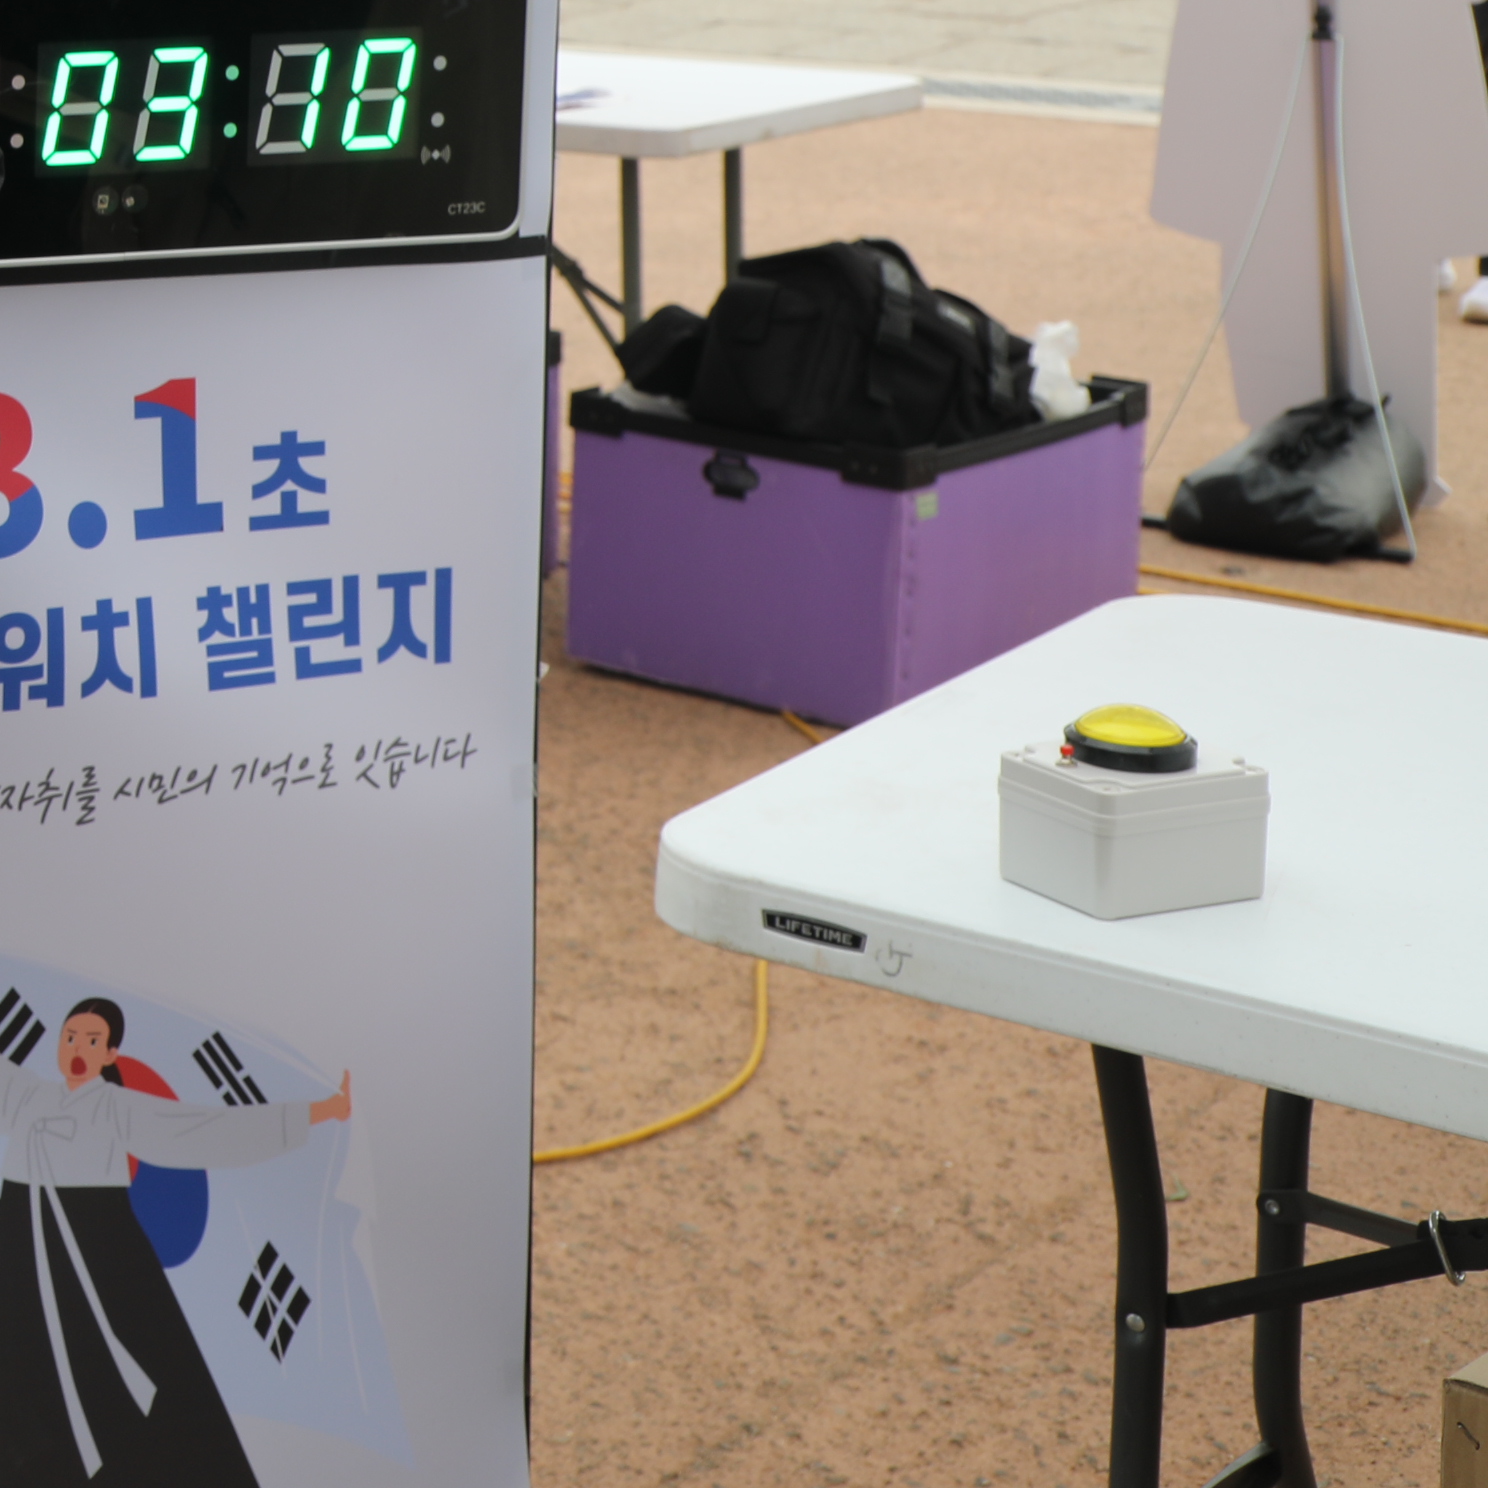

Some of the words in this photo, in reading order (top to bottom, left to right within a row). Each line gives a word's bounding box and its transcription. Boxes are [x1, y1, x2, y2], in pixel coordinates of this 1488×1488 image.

[448, 201, 486, 215] CT23C
[196, 567, 453, 692] 챌린지
[113, 763, 218, 804] 시민의
[232, 742, 340, 790] 기억으로
[355, 733, 478, 785] 잇습니다
[775, 916, 853, 946] LIFETIME
